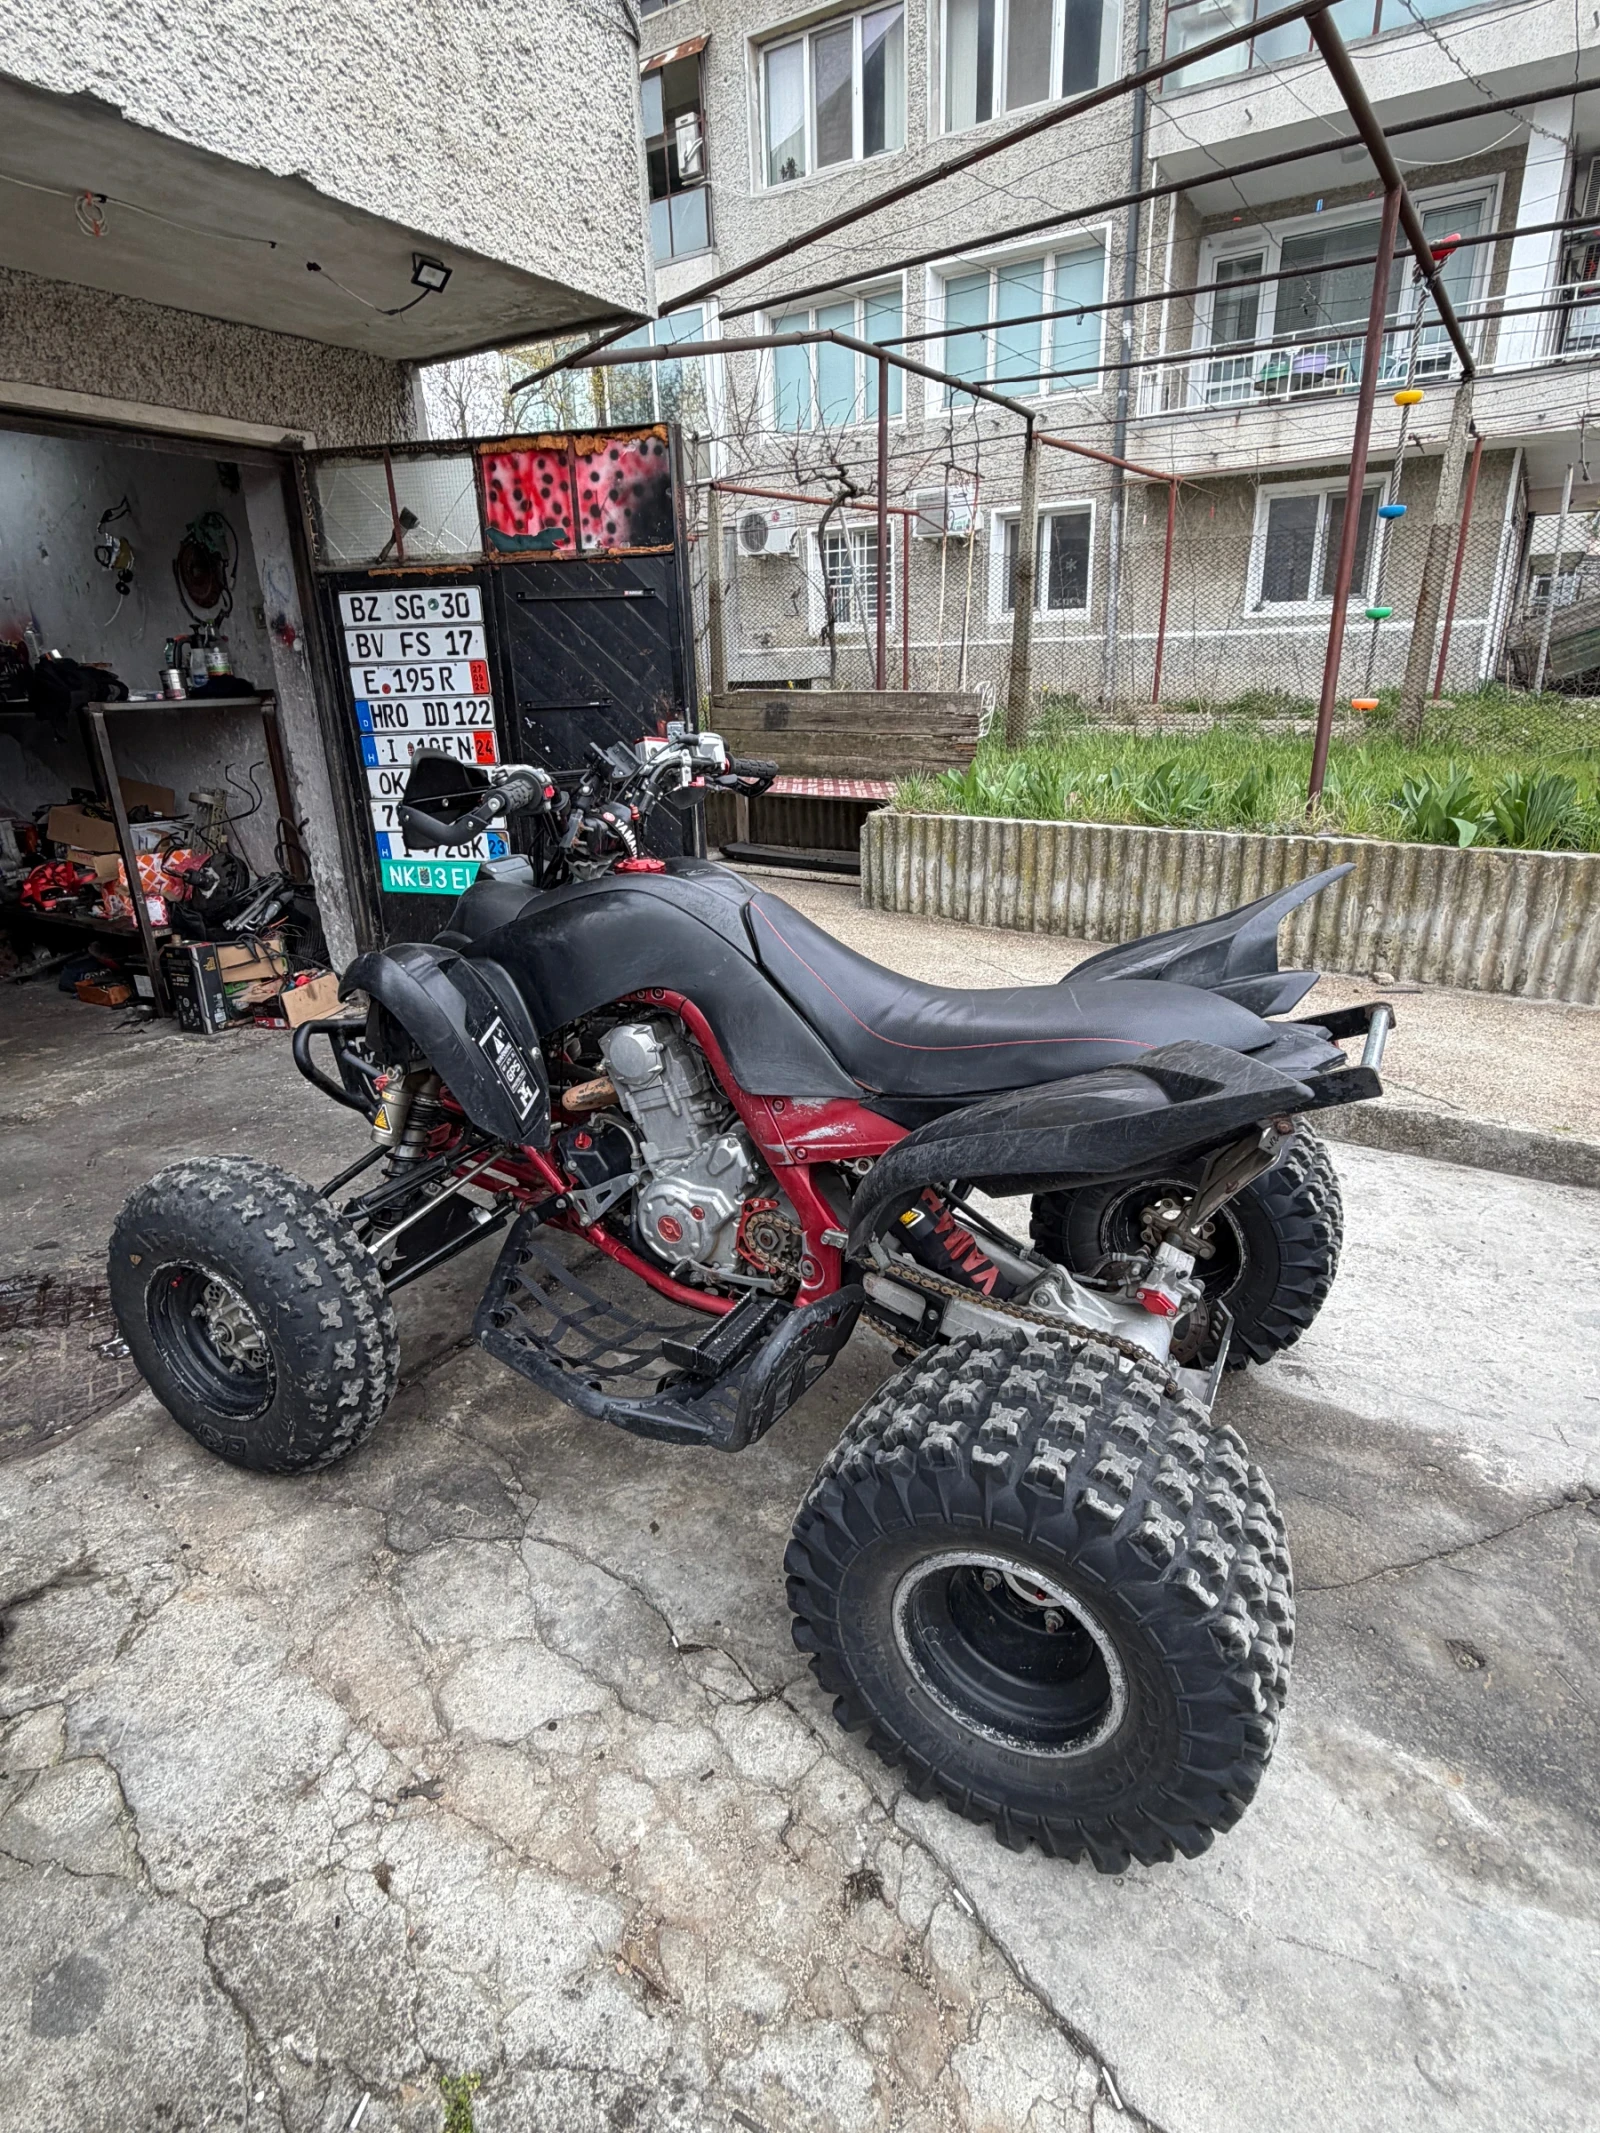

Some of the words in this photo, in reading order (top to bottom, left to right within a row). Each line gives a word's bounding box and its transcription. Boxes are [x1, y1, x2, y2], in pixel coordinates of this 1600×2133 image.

[349, 596, 382, 623] BZ
[394, 594, 426, 620] SG
[440, 592, 470, 619] 30
[355, 632, 383, 659] BV
[399, 631, 431, 657] FS
[445, 629, 473, 656] 17
[363, 670, 380, 694] E
[370, 703, 409, 728] HRO
[422, 701, 450, 727] DD
[453, 699, 492, 726] 122
[368, 754, 375, 763] H
[387, 739, 398, 763] I
[476, 739, 494, 756] 24
[489, 839, 506, 855] 23
[615, 819, 638, 859] YAMA
[381, 849, 389, 857] H
[389, 865, 417, 887] NK
[434, 867, 447, 889] 3
[506, 1059, 521, 1082] GPS
